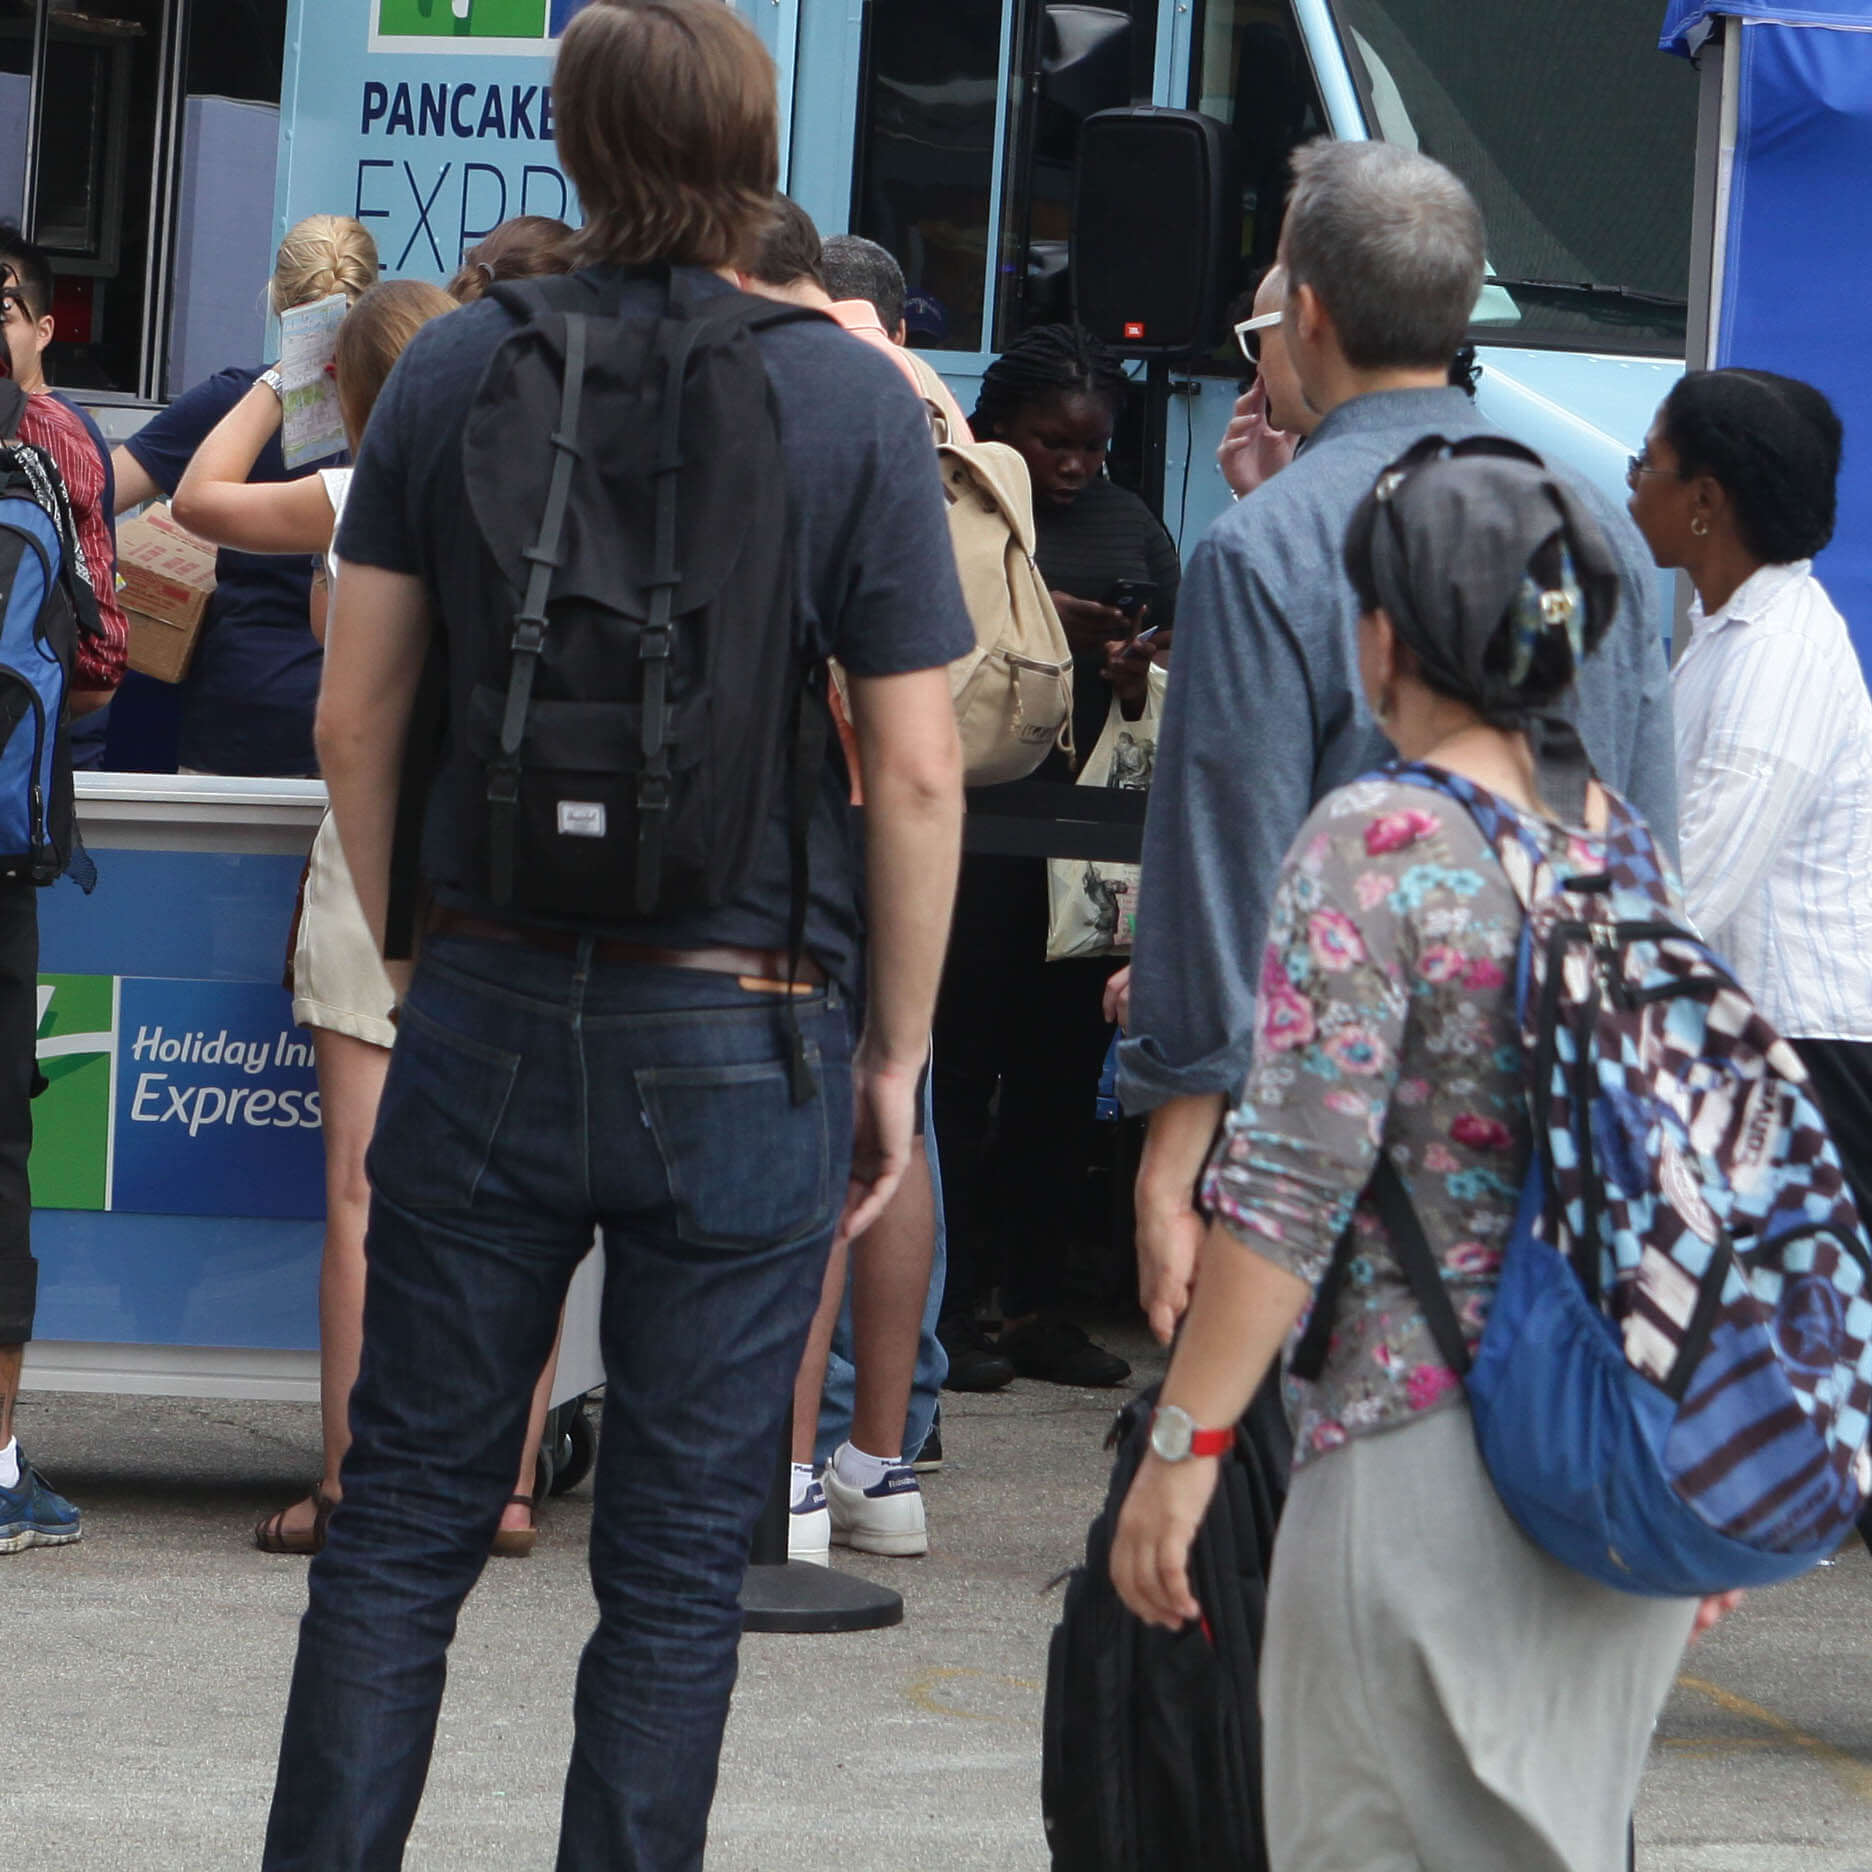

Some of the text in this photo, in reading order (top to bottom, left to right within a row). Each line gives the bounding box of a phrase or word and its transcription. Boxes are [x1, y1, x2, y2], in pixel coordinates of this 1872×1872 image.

[360, 81, 557, 140] PANCAKE
[131, 1025, 270, 1075] Holiday
[130, 1072, 323, 1138] Express
